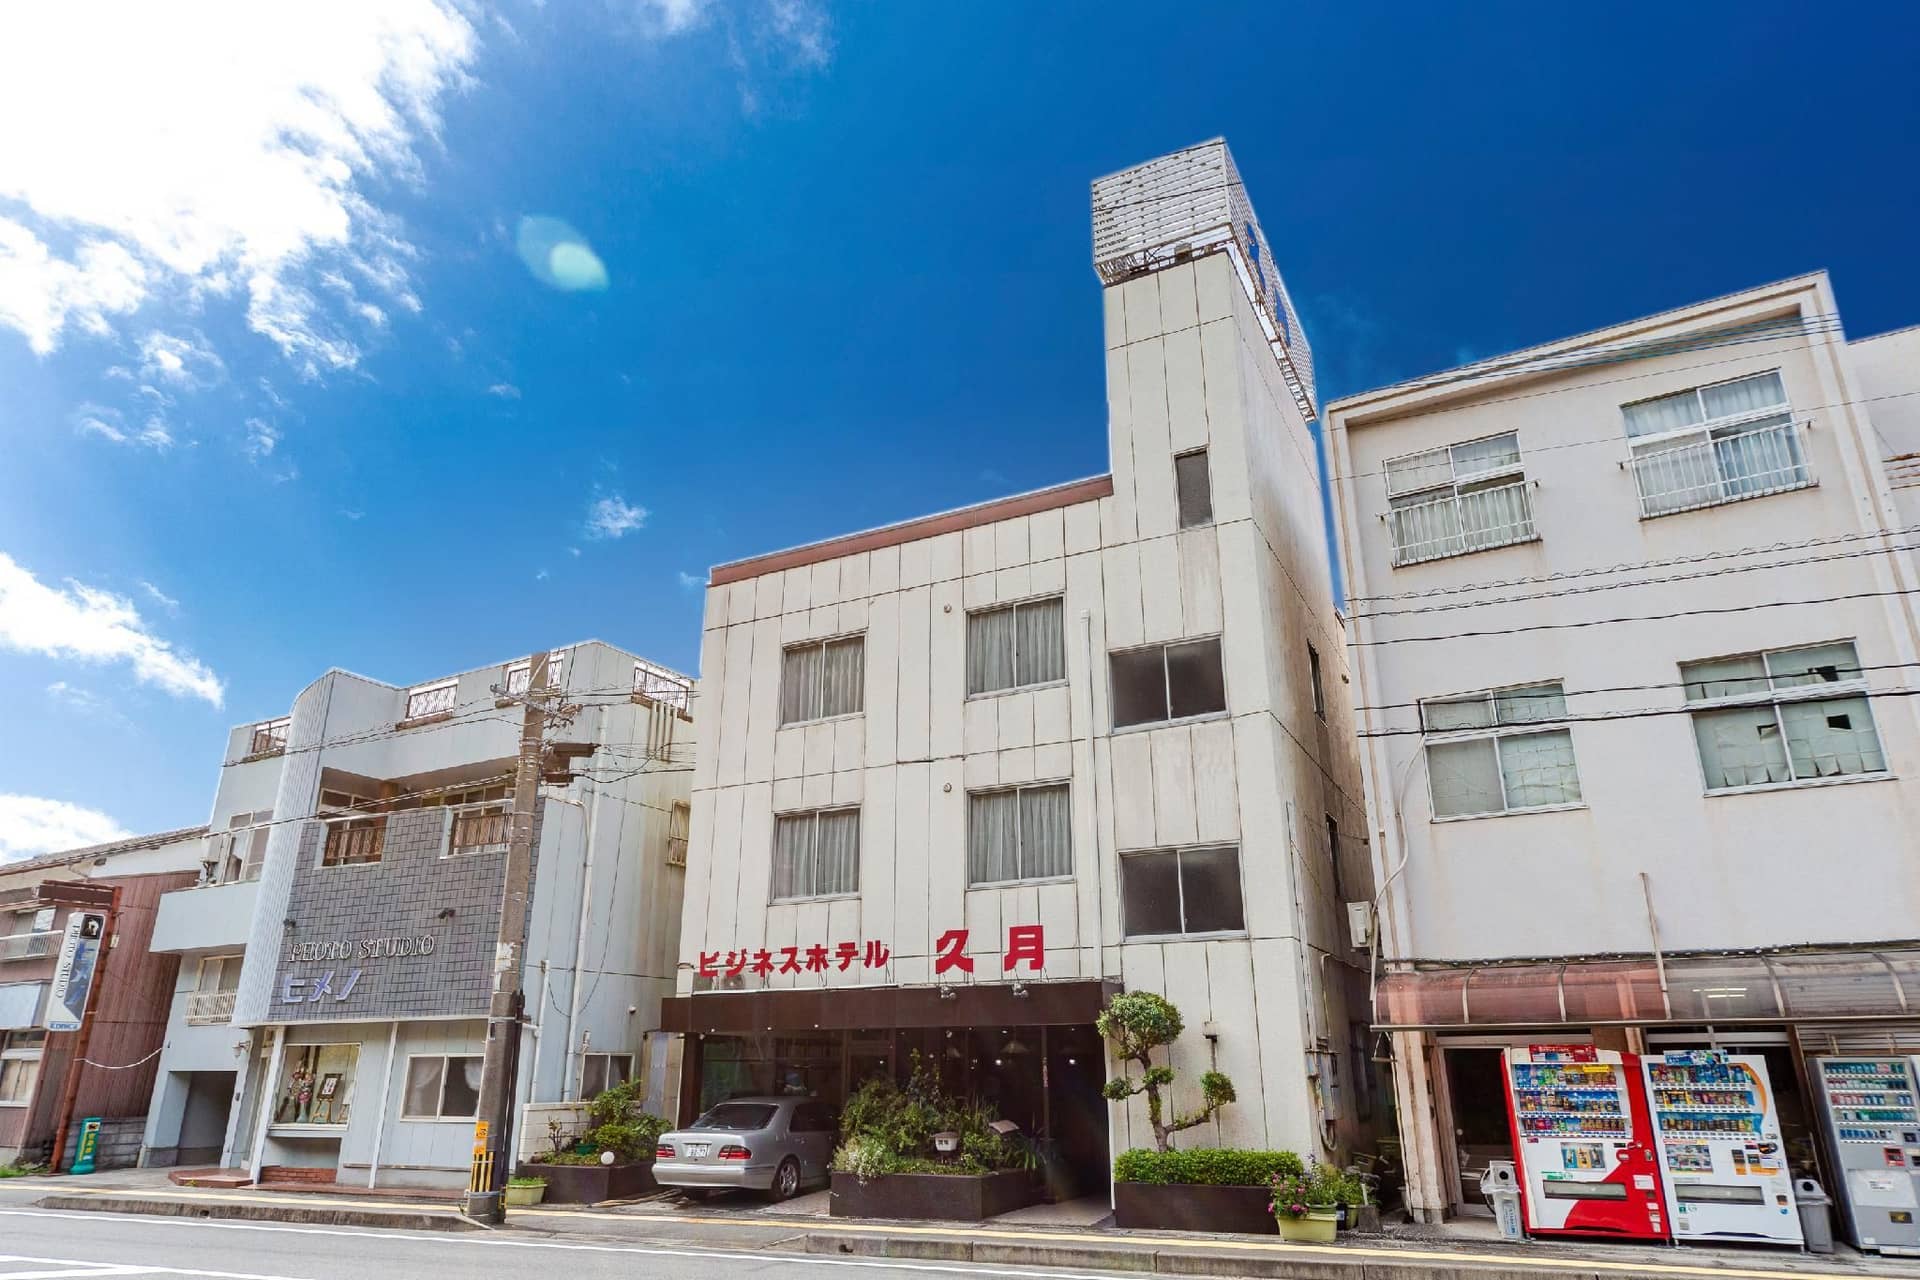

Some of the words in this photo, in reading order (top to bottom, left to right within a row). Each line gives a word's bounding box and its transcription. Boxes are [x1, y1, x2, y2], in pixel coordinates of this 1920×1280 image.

[287, 940, 352, 962] PHOTO
[358, 934, 434, 960] STUDIO
[700, 940, 890, 978] ビジネスホテル
[936, 925, 1044, 975] 久月
[282, 969, 363, 1004] ヒメノ
